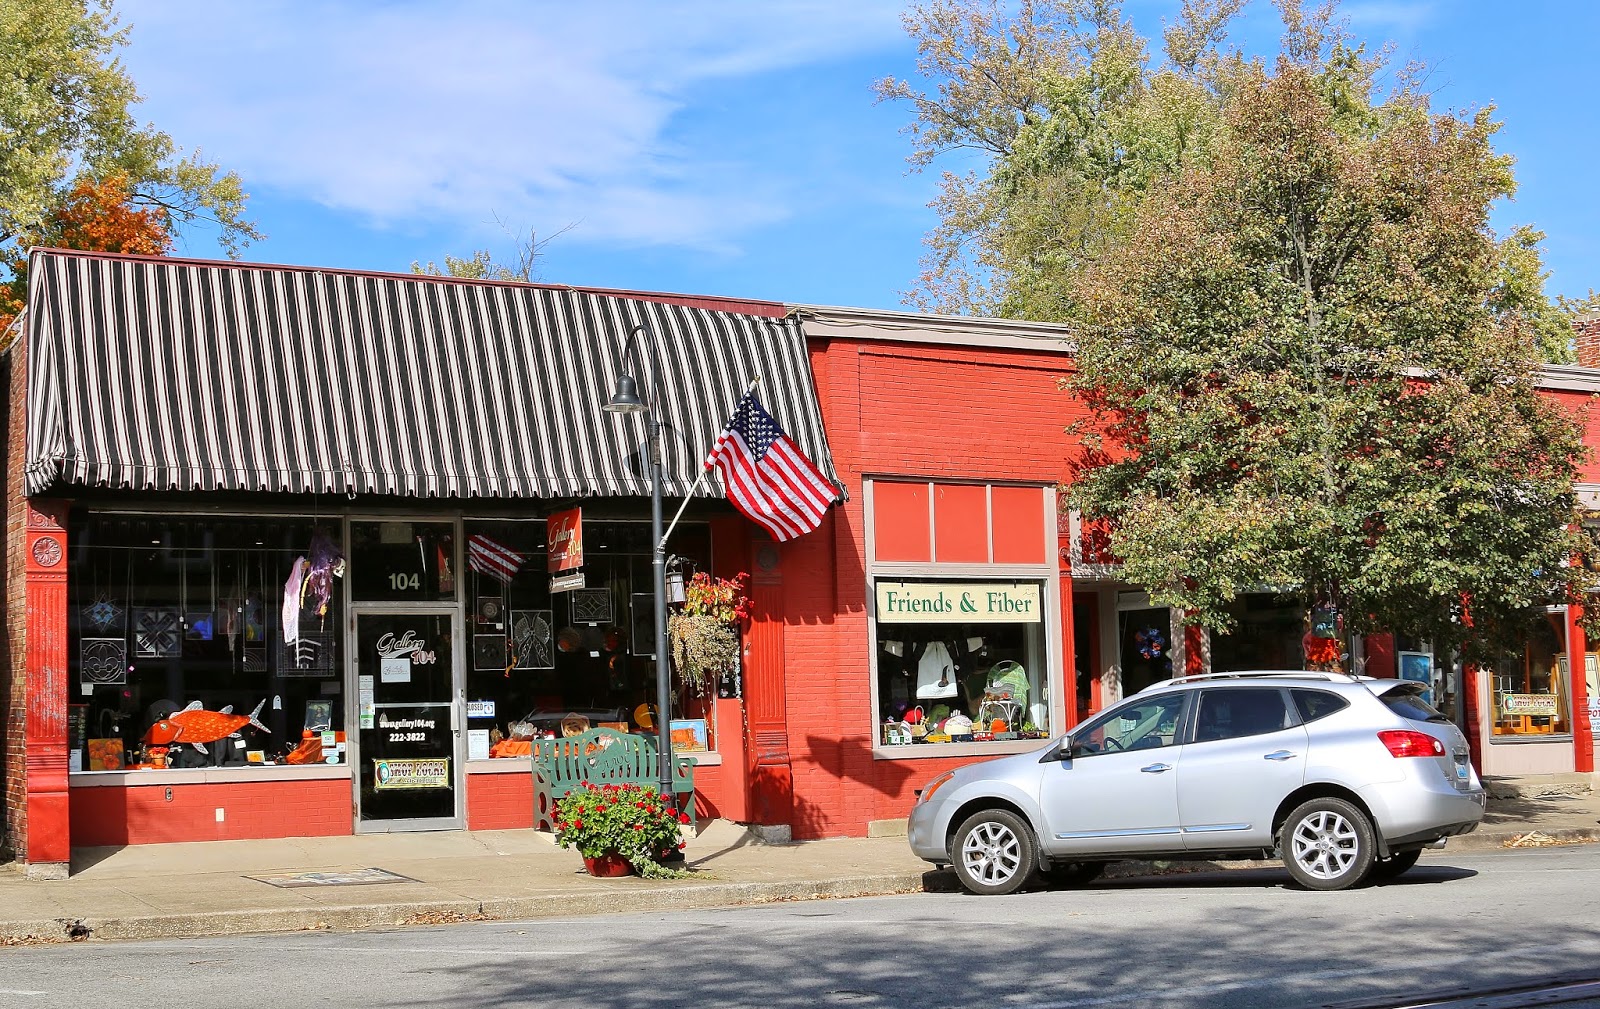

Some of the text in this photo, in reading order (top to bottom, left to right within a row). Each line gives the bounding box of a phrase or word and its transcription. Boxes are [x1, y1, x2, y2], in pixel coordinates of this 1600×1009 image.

[548, 517, 576, 553] Gallery
[568, 539, 581, 557] 104
[388, 573, 420, 590] 104
[886, 591, 1032, 613] Friends & Fiber
[376, 630, 425, 657] Gallery
[411, 650, 436, 665] 104
[467, 703, 484, 711] LOSED
[379, 718, 435, 730] www.gallery104.org
[389, 732, 426, 742] 222-3822
